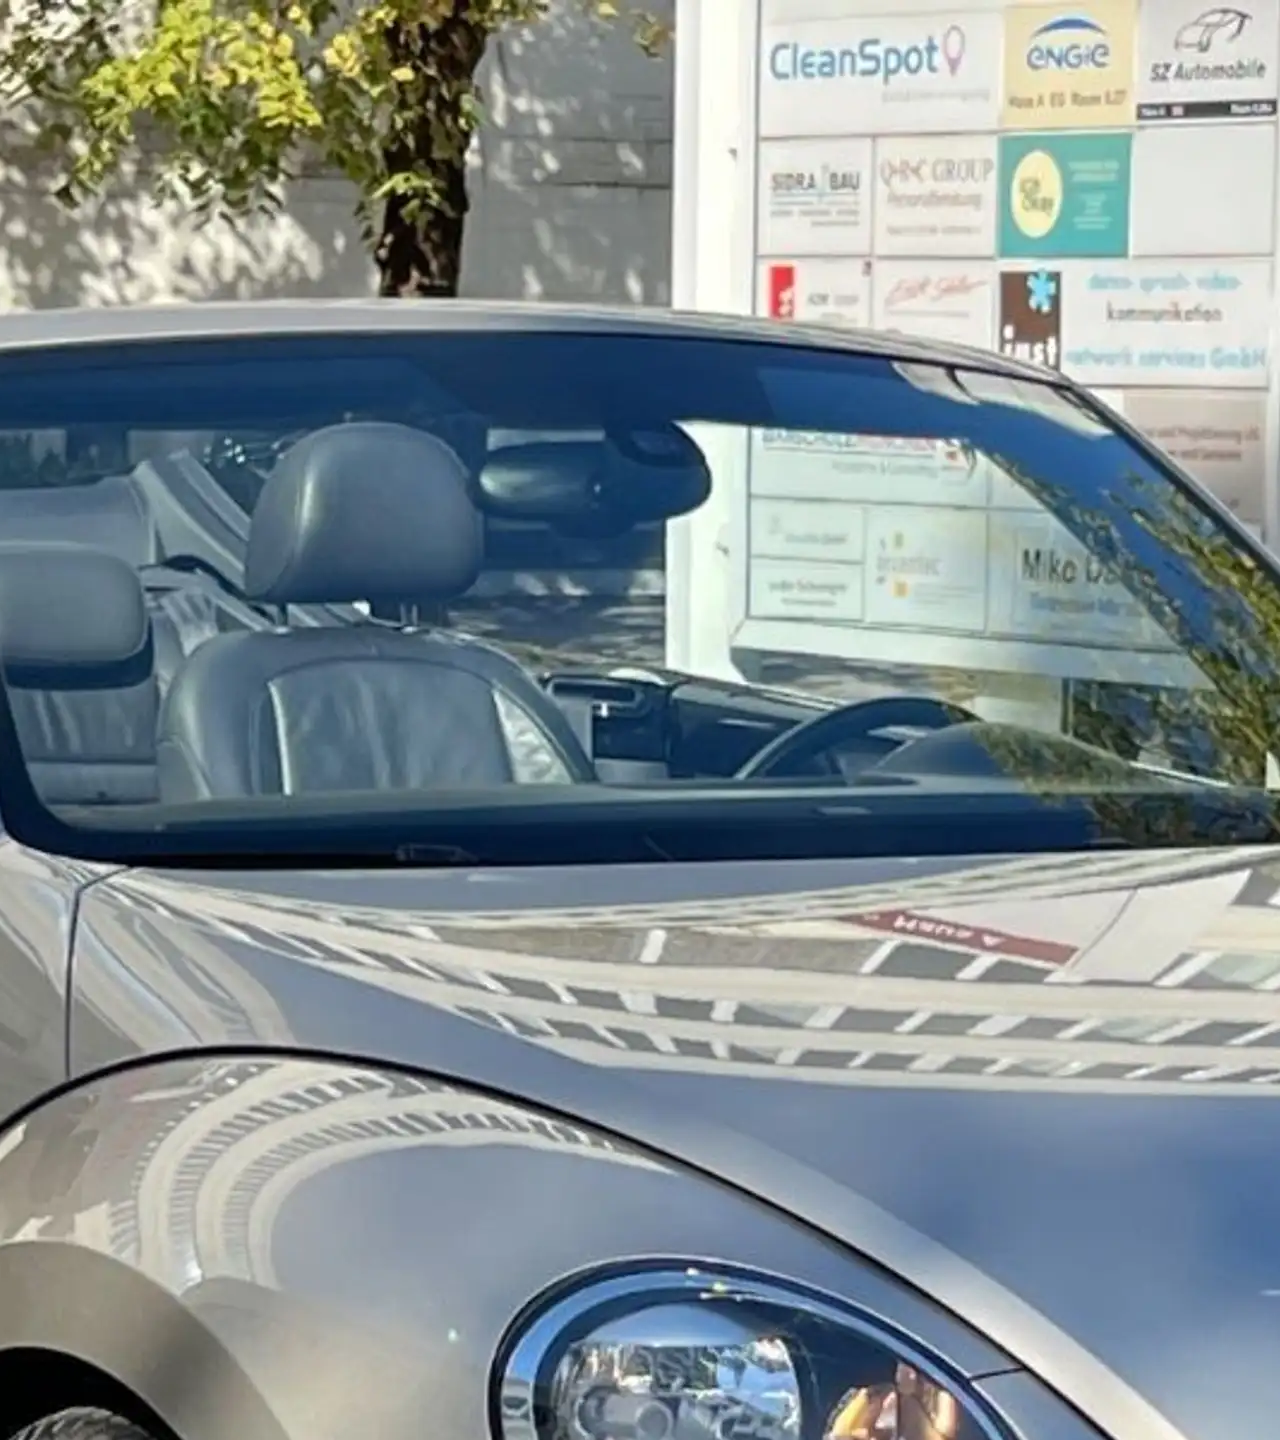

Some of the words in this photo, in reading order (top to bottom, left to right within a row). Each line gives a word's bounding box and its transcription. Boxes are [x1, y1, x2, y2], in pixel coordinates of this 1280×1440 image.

[770, 35, 939, 85] CleanSpot
[1149, 62, 1173, 83] SZ
[1174, 57, 1267, 81] Automobile
[829, 171, 861, 191] BAU
[931, 157, 995, 182] GROUP
[1210, 346, 1267, 369] GmbH
[1023, 549, 1078, 584] Miko
